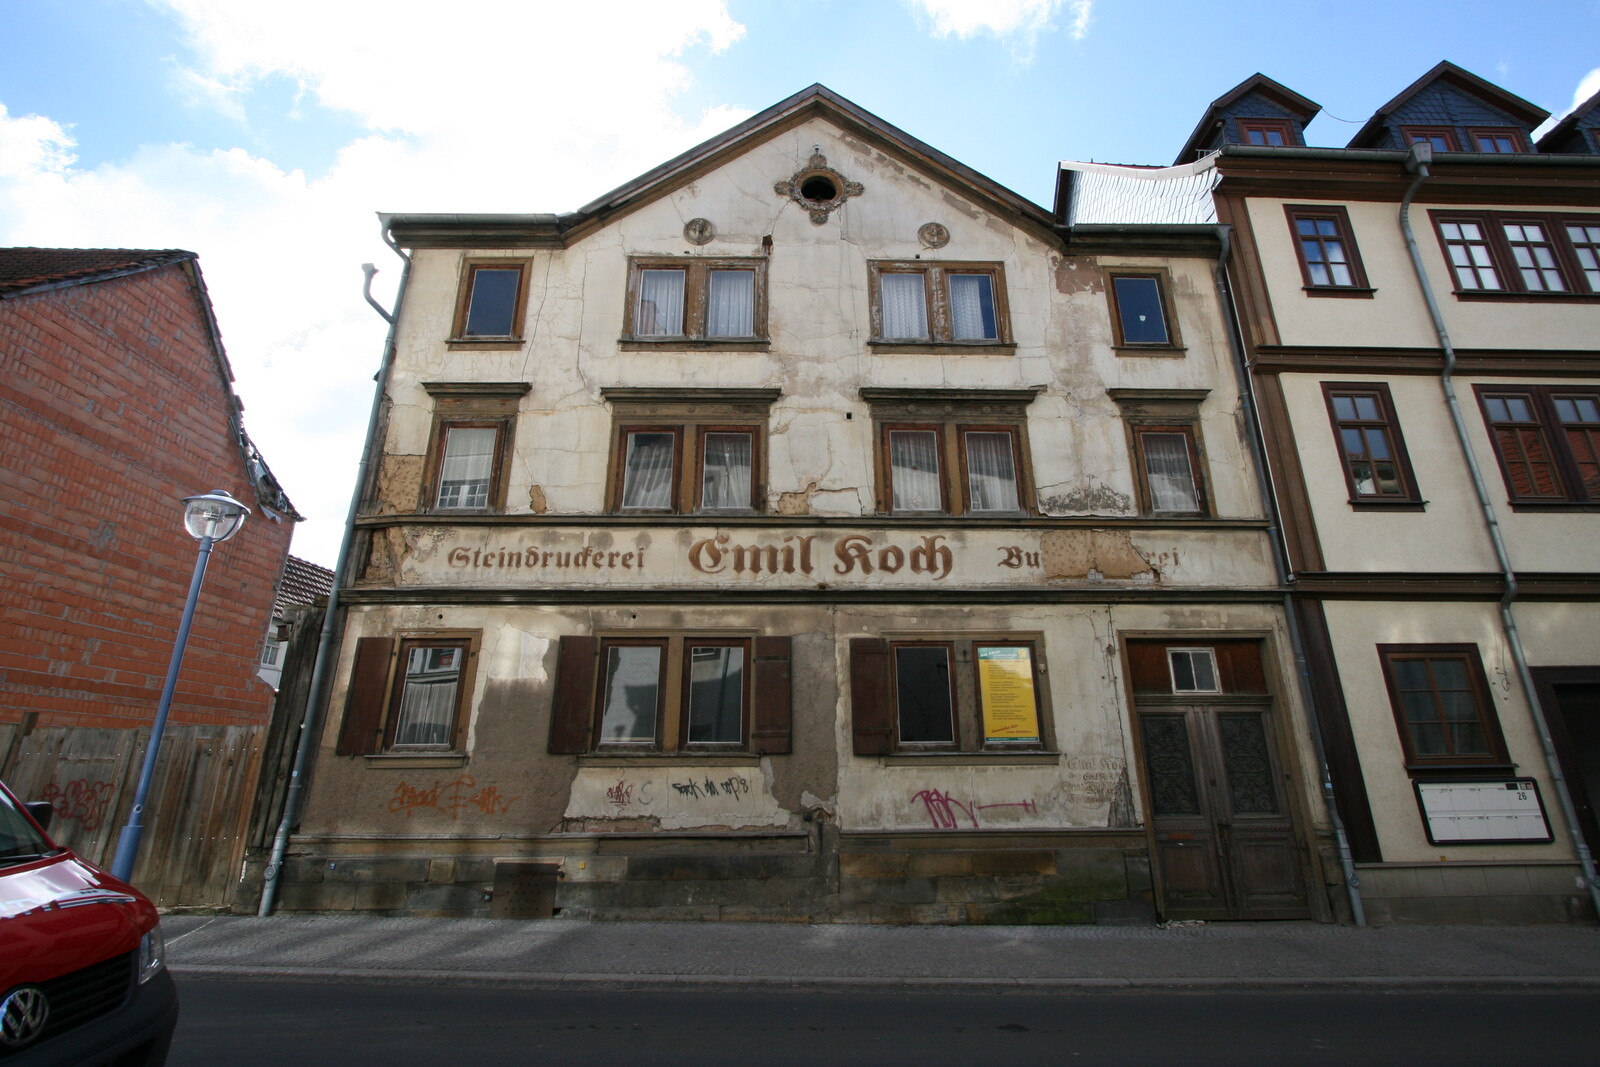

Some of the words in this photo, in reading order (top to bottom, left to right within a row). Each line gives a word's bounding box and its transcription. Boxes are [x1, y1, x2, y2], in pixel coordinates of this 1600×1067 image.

[447, 546, 645, 570] Steindruckerei
[688, 535, 815, 575] Emil
[833, 534, 954, 581] Koch
[1517, 792, 1527, 800] 26
